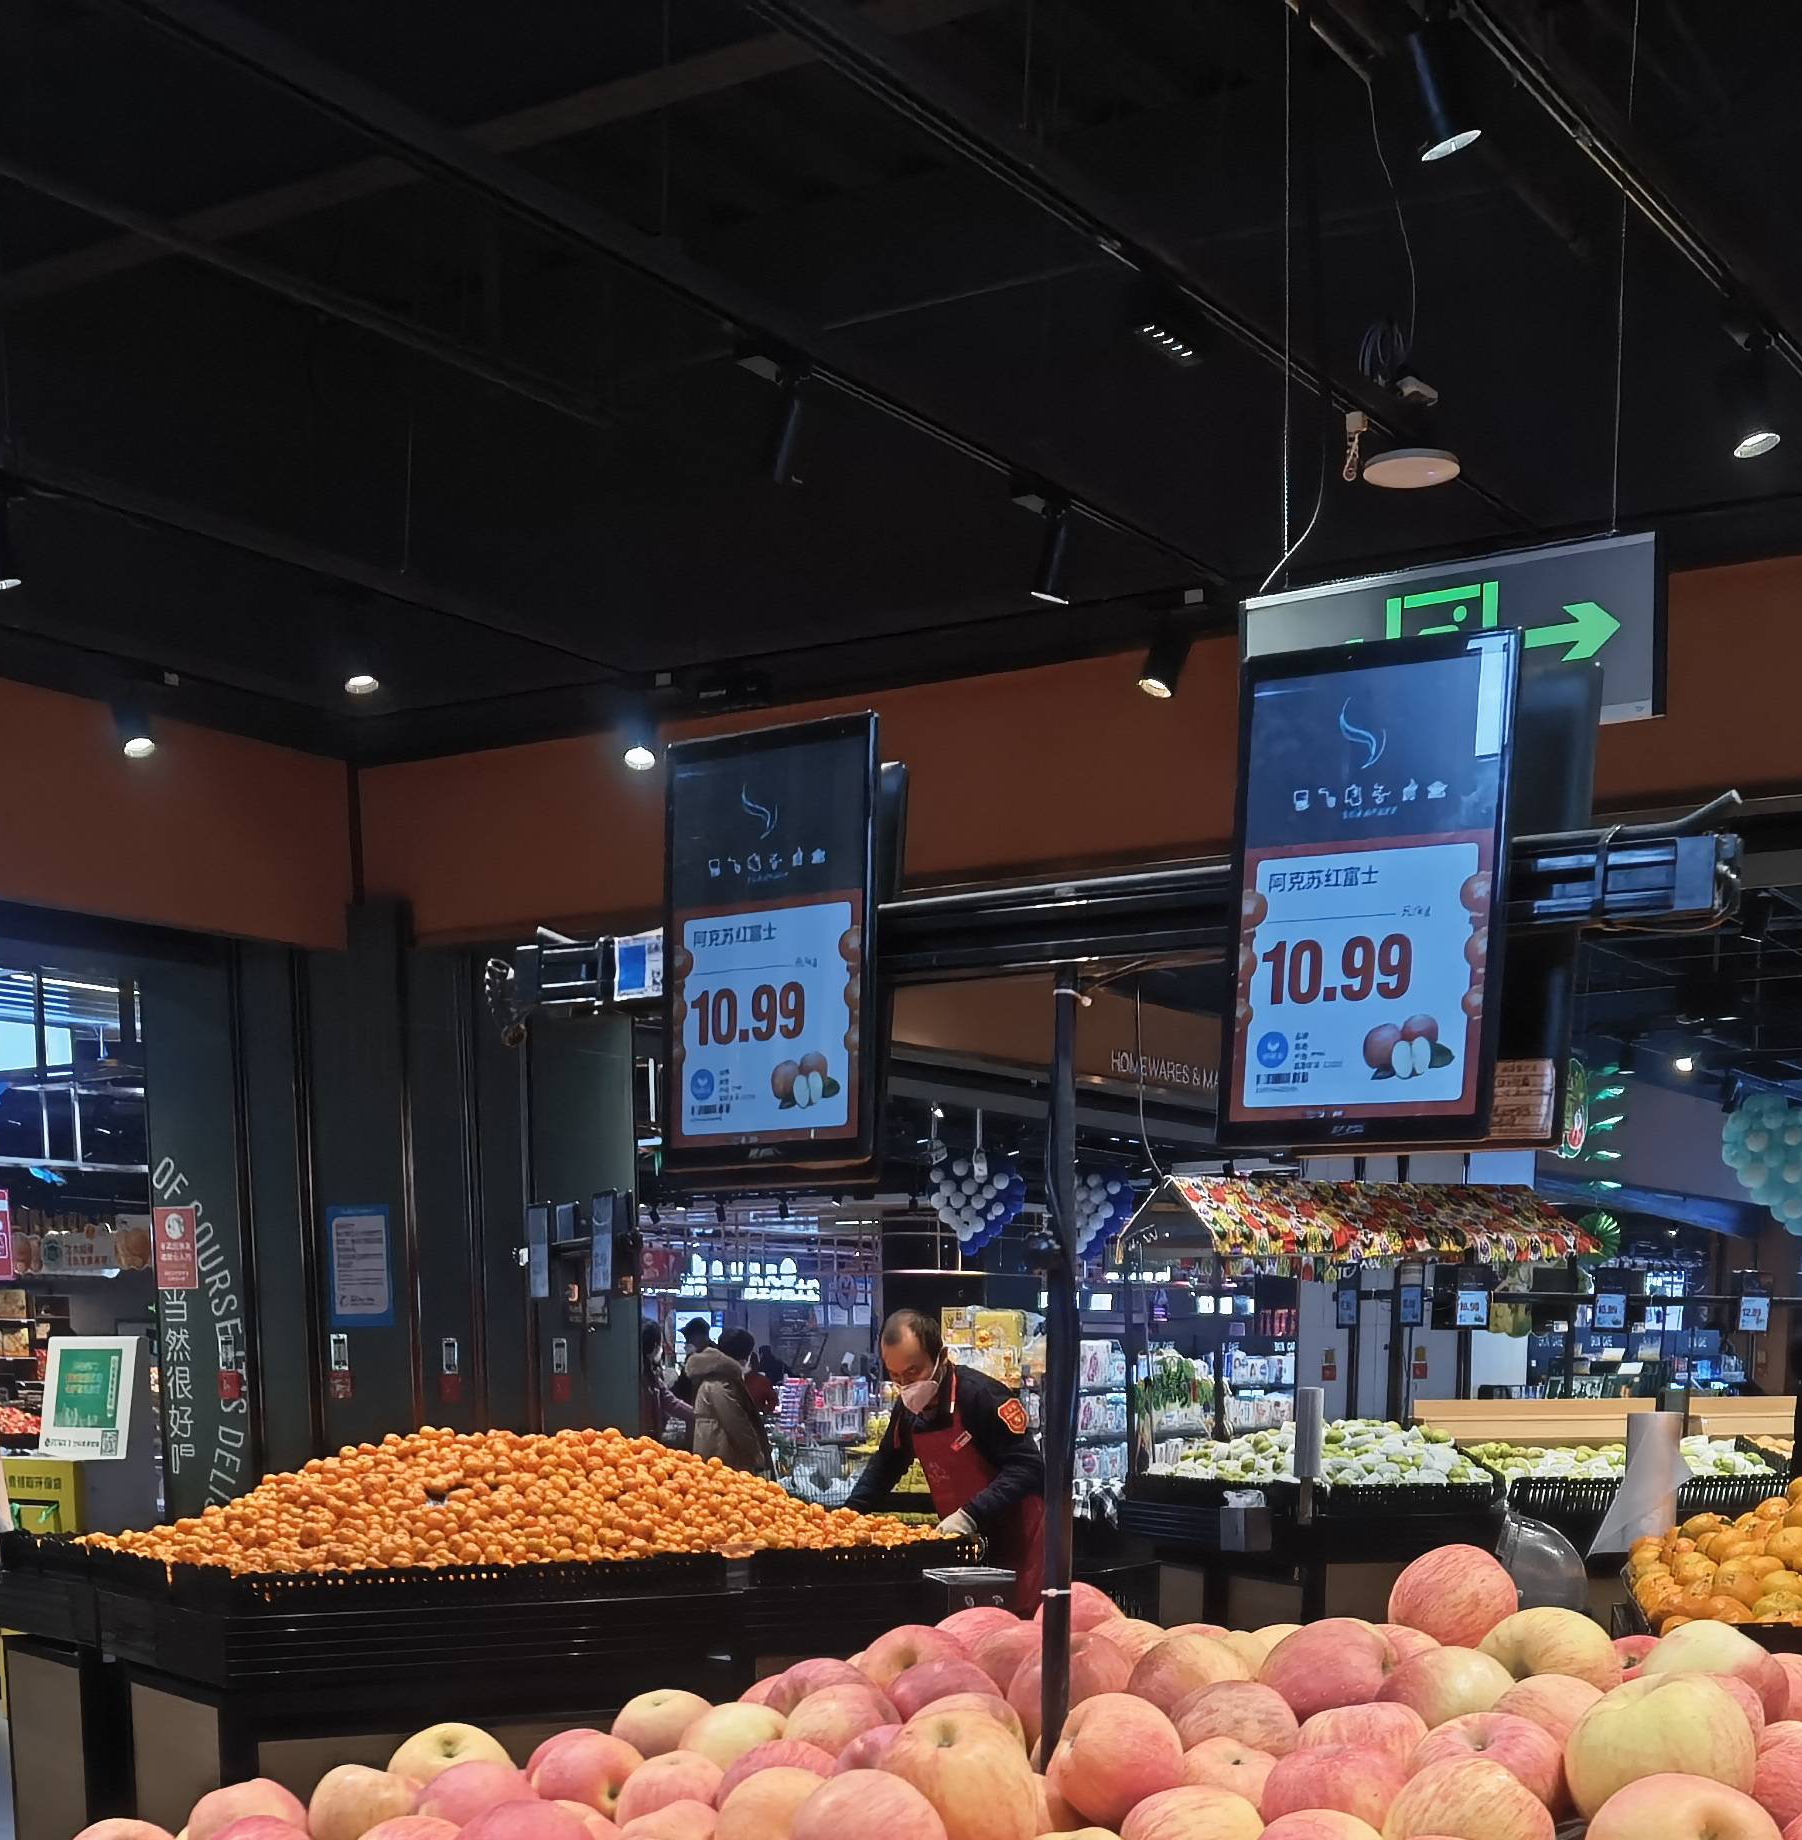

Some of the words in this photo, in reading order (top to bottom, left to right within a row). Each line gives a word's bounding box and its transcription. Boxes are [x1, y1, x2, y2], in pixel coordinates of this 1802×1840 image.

[1268, 866, 1379, 893] 阿克苏红富士
[1262, 933, 1412, 1005] 10.99
[691, 981, 805, 1046] 10.99
[1111, 1048, 1190, 1085] HOMEWARES
[1192, 1067, 1201, 1086] &
[153, 1156, 189, 1200] OF
